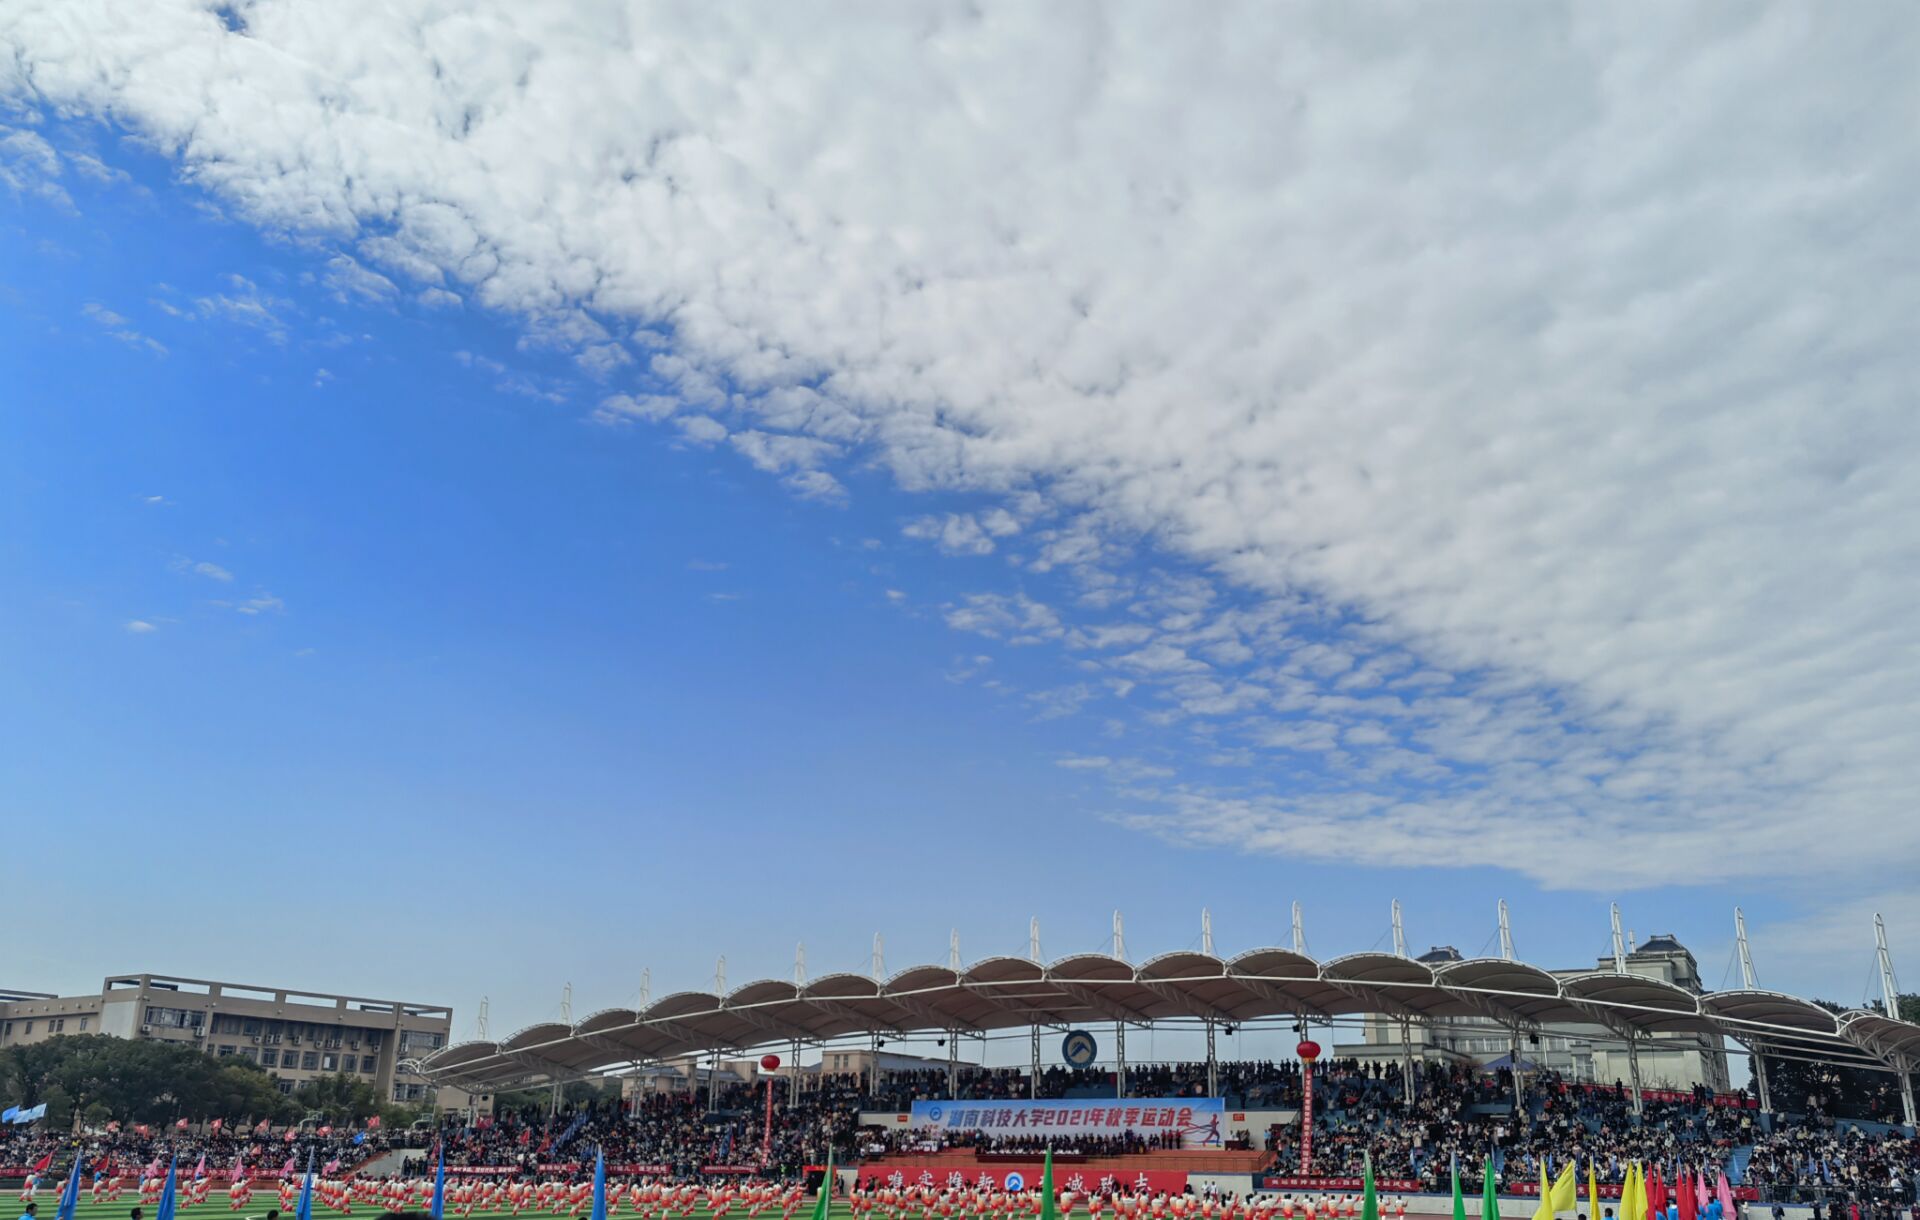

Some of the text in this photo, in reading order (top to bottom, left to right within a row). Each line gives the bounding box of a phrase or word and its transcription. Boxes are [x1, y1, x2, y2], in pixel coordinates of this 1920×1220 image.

[947, 1107, 1192, 1128] 湖南科技大学2021年秋季运动会
